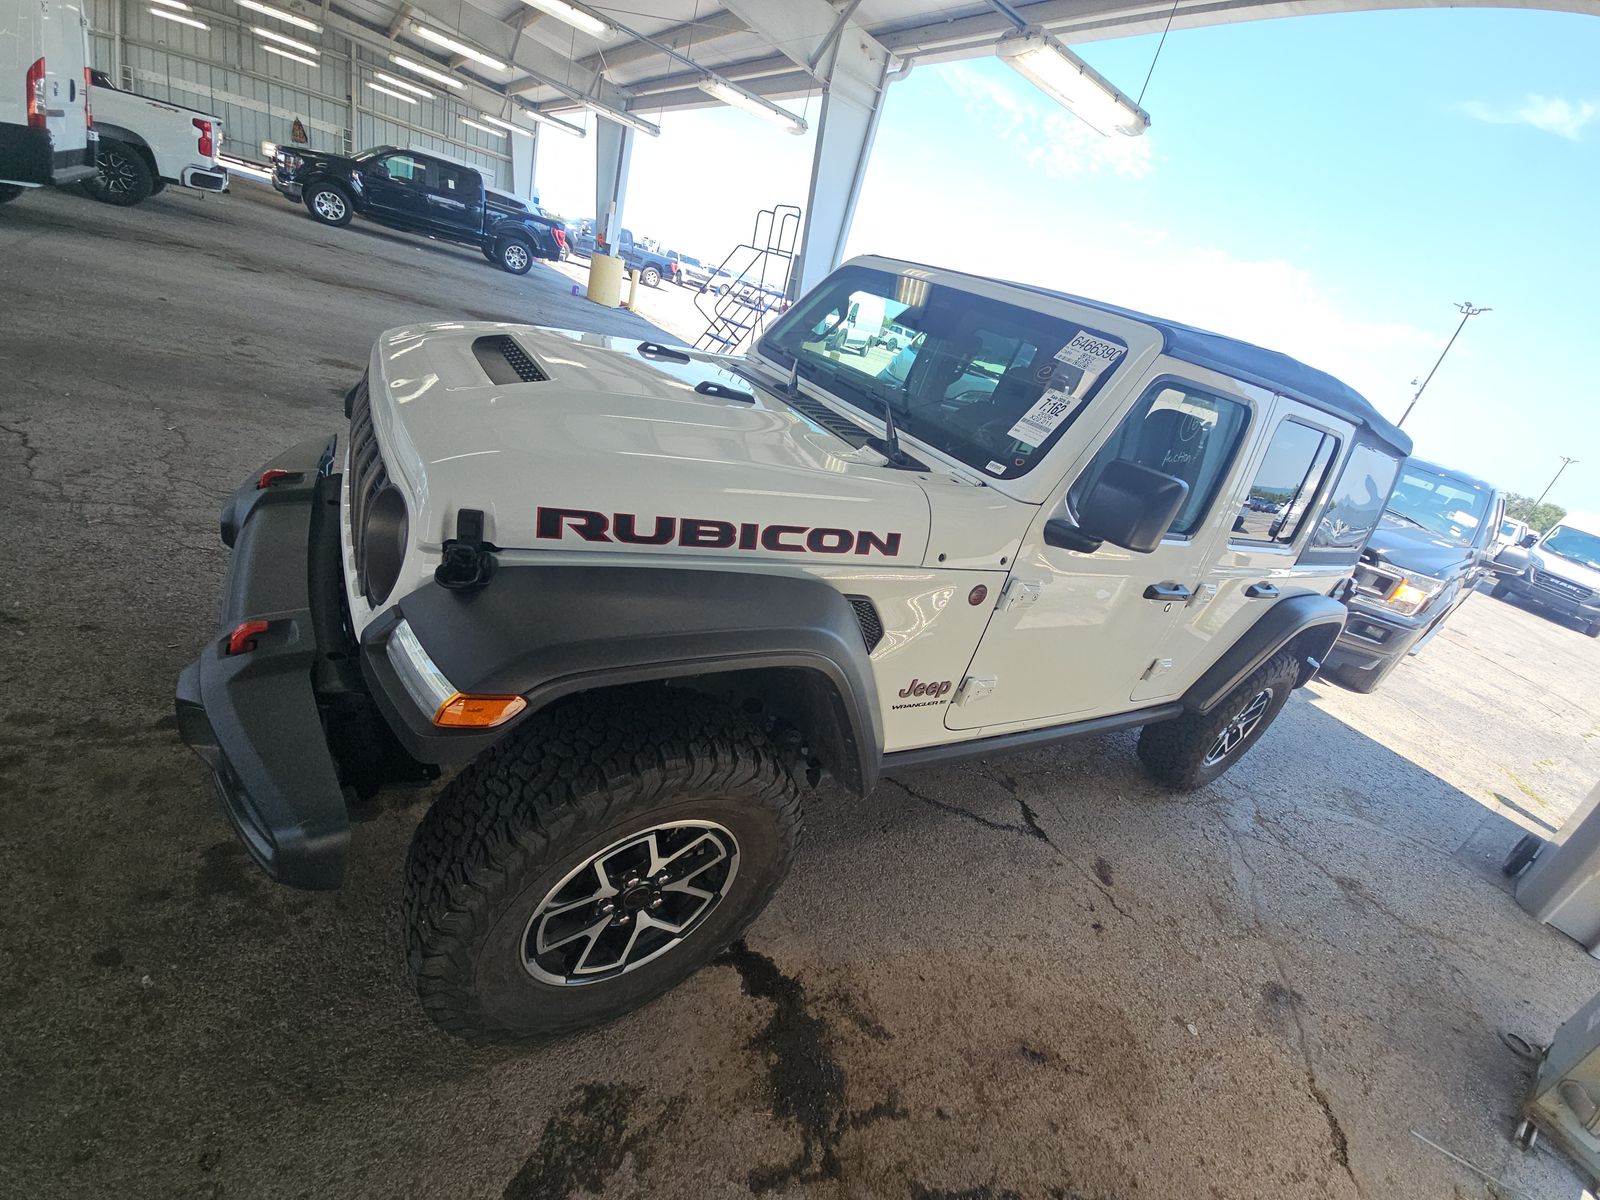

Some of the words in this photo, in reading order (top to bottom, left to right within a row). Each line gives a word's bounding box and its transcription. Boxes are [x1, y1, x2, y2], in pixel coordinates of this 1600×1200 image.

[1071, 335, 1122, 361] 6466390
[1039, 398, 1067, 416] 7:162
[536, 506, 902, 556] RUBICON
[898, 679, 952, 699] Jeep
[892, 700, 939, 710] WRANGLER
